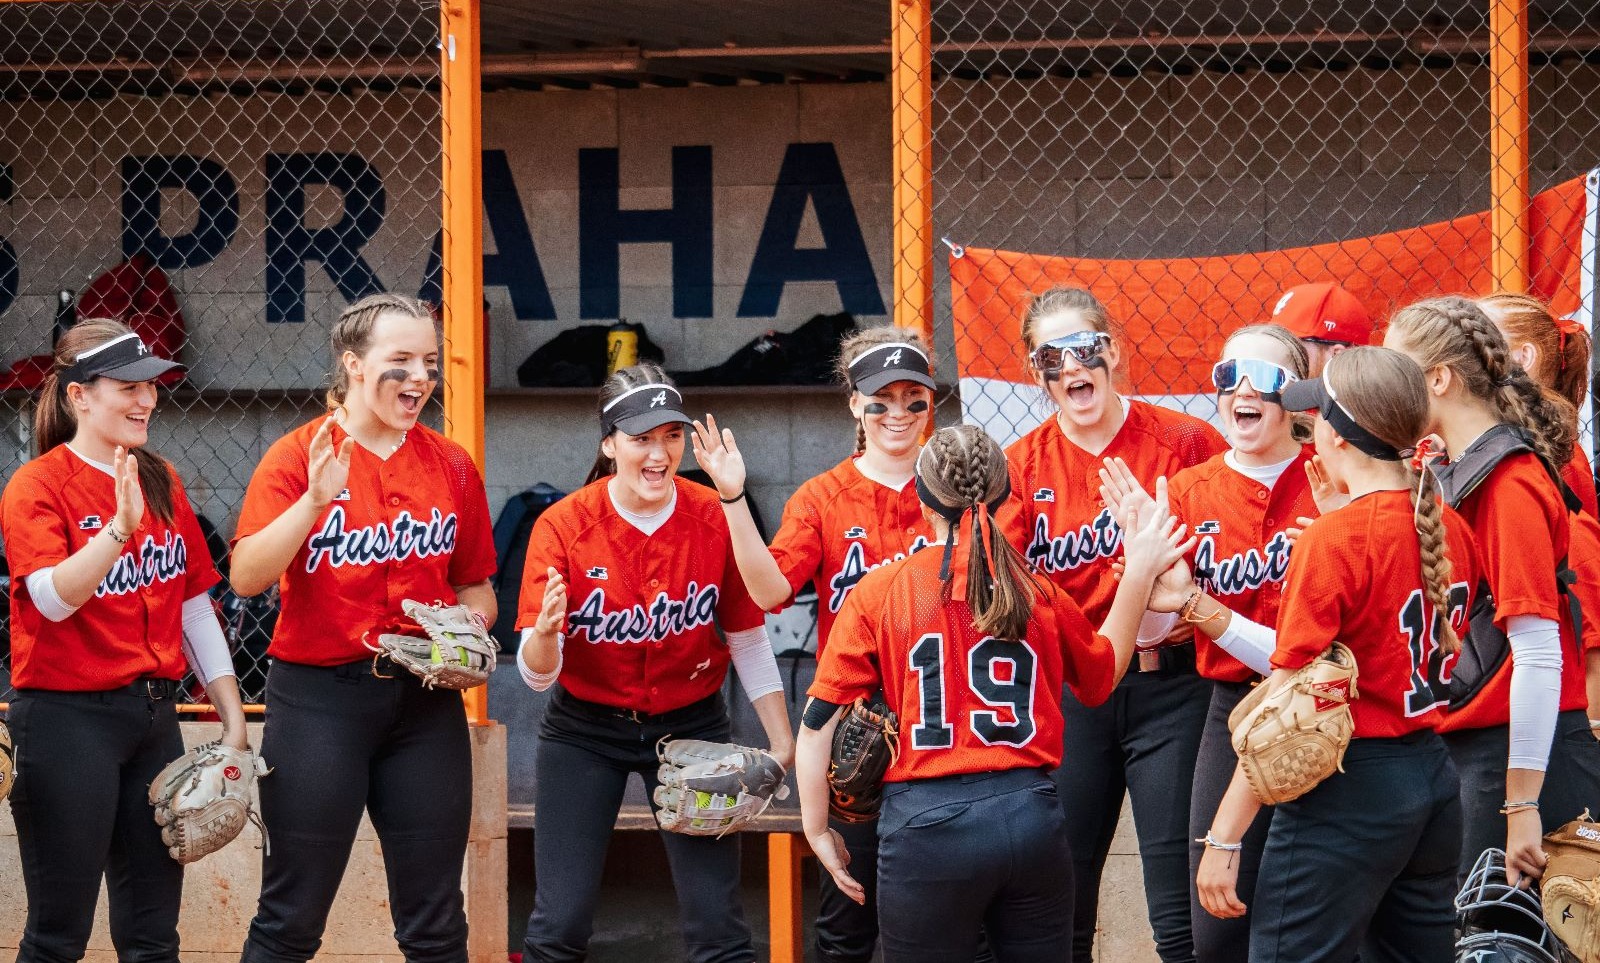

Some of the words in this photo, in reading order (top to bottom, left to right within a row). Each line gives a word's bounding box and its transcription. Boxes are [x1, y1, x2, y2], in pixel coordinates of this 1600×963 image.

[121, 142, 887, 323] PRAHA
[883, 349, 902, 367] A
[650, 390, 667, 408] A
[93, 530, 187, 597] ustria
[306, 505, 457, 573] Austria
[1025, 508, 1124, 574] Aust
[1194, 531, 1290, 596] Aust
[568, 581, 719, 644] Austria
[909, 633, 1037, 749] 19
